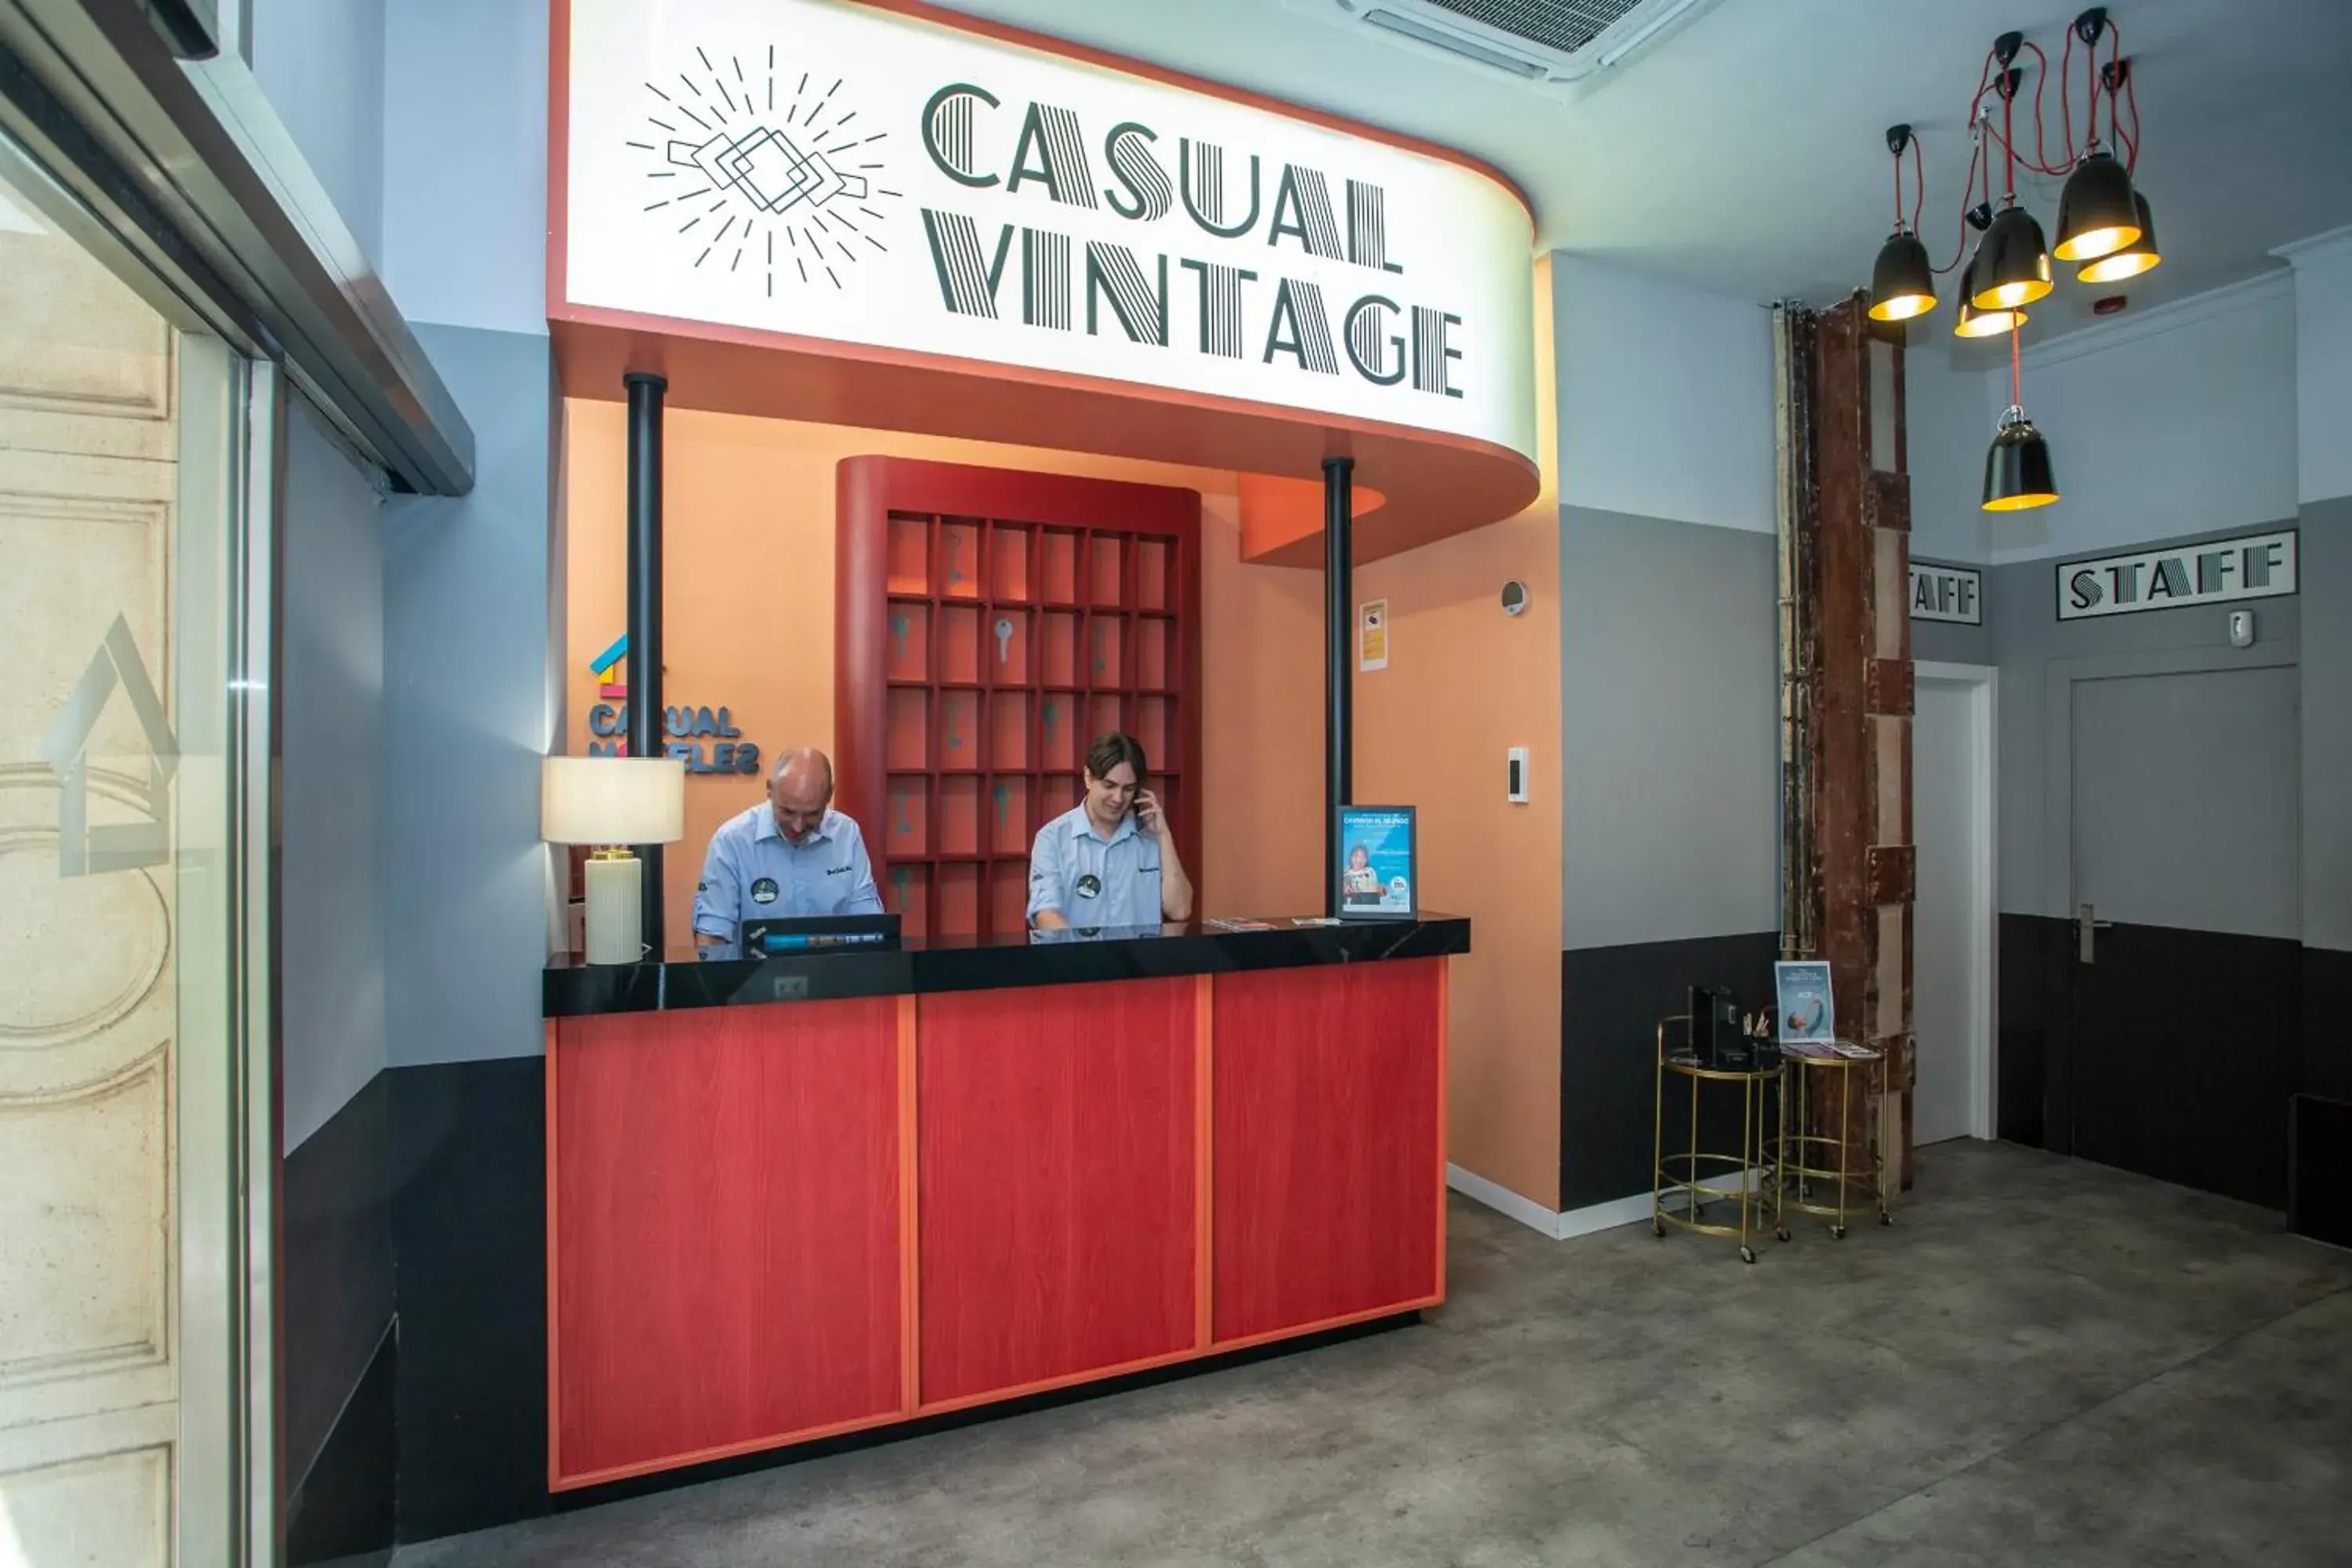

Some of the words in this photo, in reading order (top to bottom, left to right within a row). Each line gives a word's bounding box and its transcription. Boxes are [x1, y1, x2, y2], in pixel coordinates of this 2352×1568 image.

[921, 82, 1403, 274] CASUAL
[920, 207, 1464, 399] VINTAGE
[1909, 572, 1975, 615] AFF
[2071, 543, 2282, 609] STAFF
[590, 704, 741, 738] CAUAL
